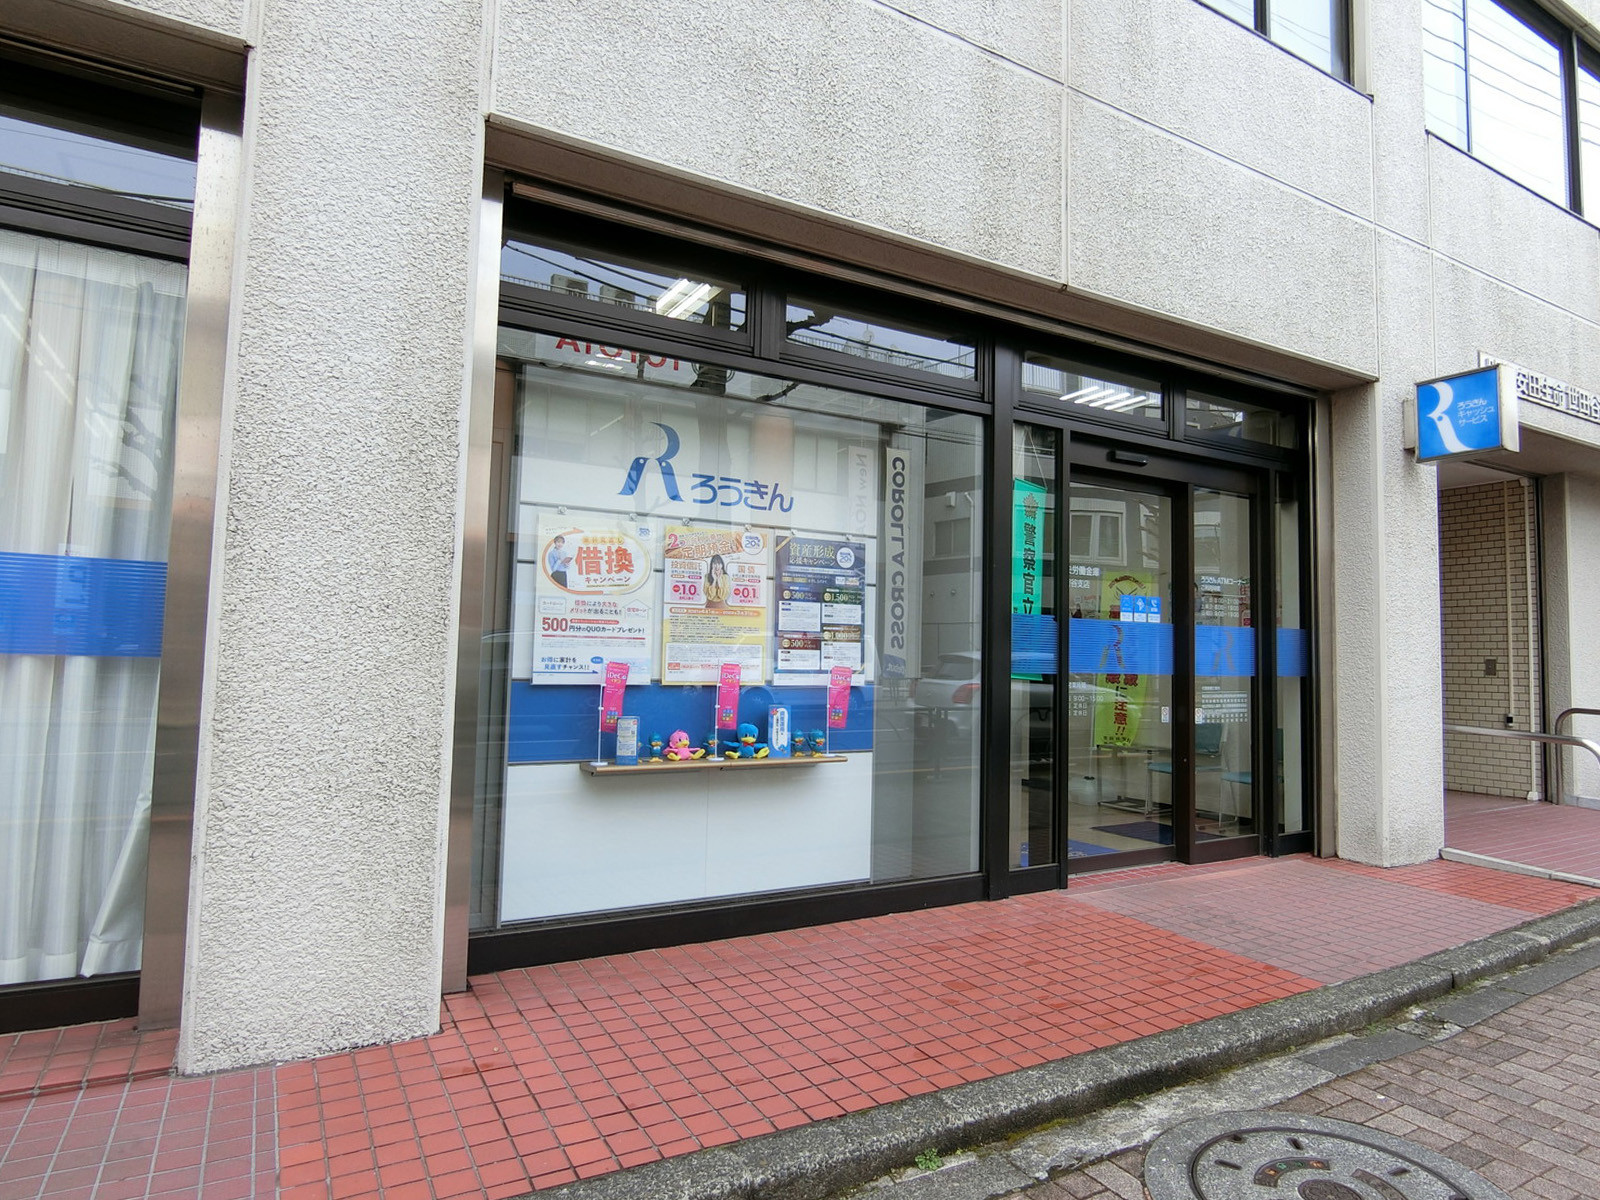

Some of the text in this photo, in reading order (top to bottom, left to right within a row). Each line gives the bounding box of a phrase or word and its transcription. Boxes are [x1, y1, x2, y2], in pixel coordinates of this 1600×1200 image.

[691, 473, 794, 513] ろうきん
[575, 545, 634, 575] 借換
[789, 542, 835, 559] 資産形成
[585, 576, 631, 584] キャンペーン
